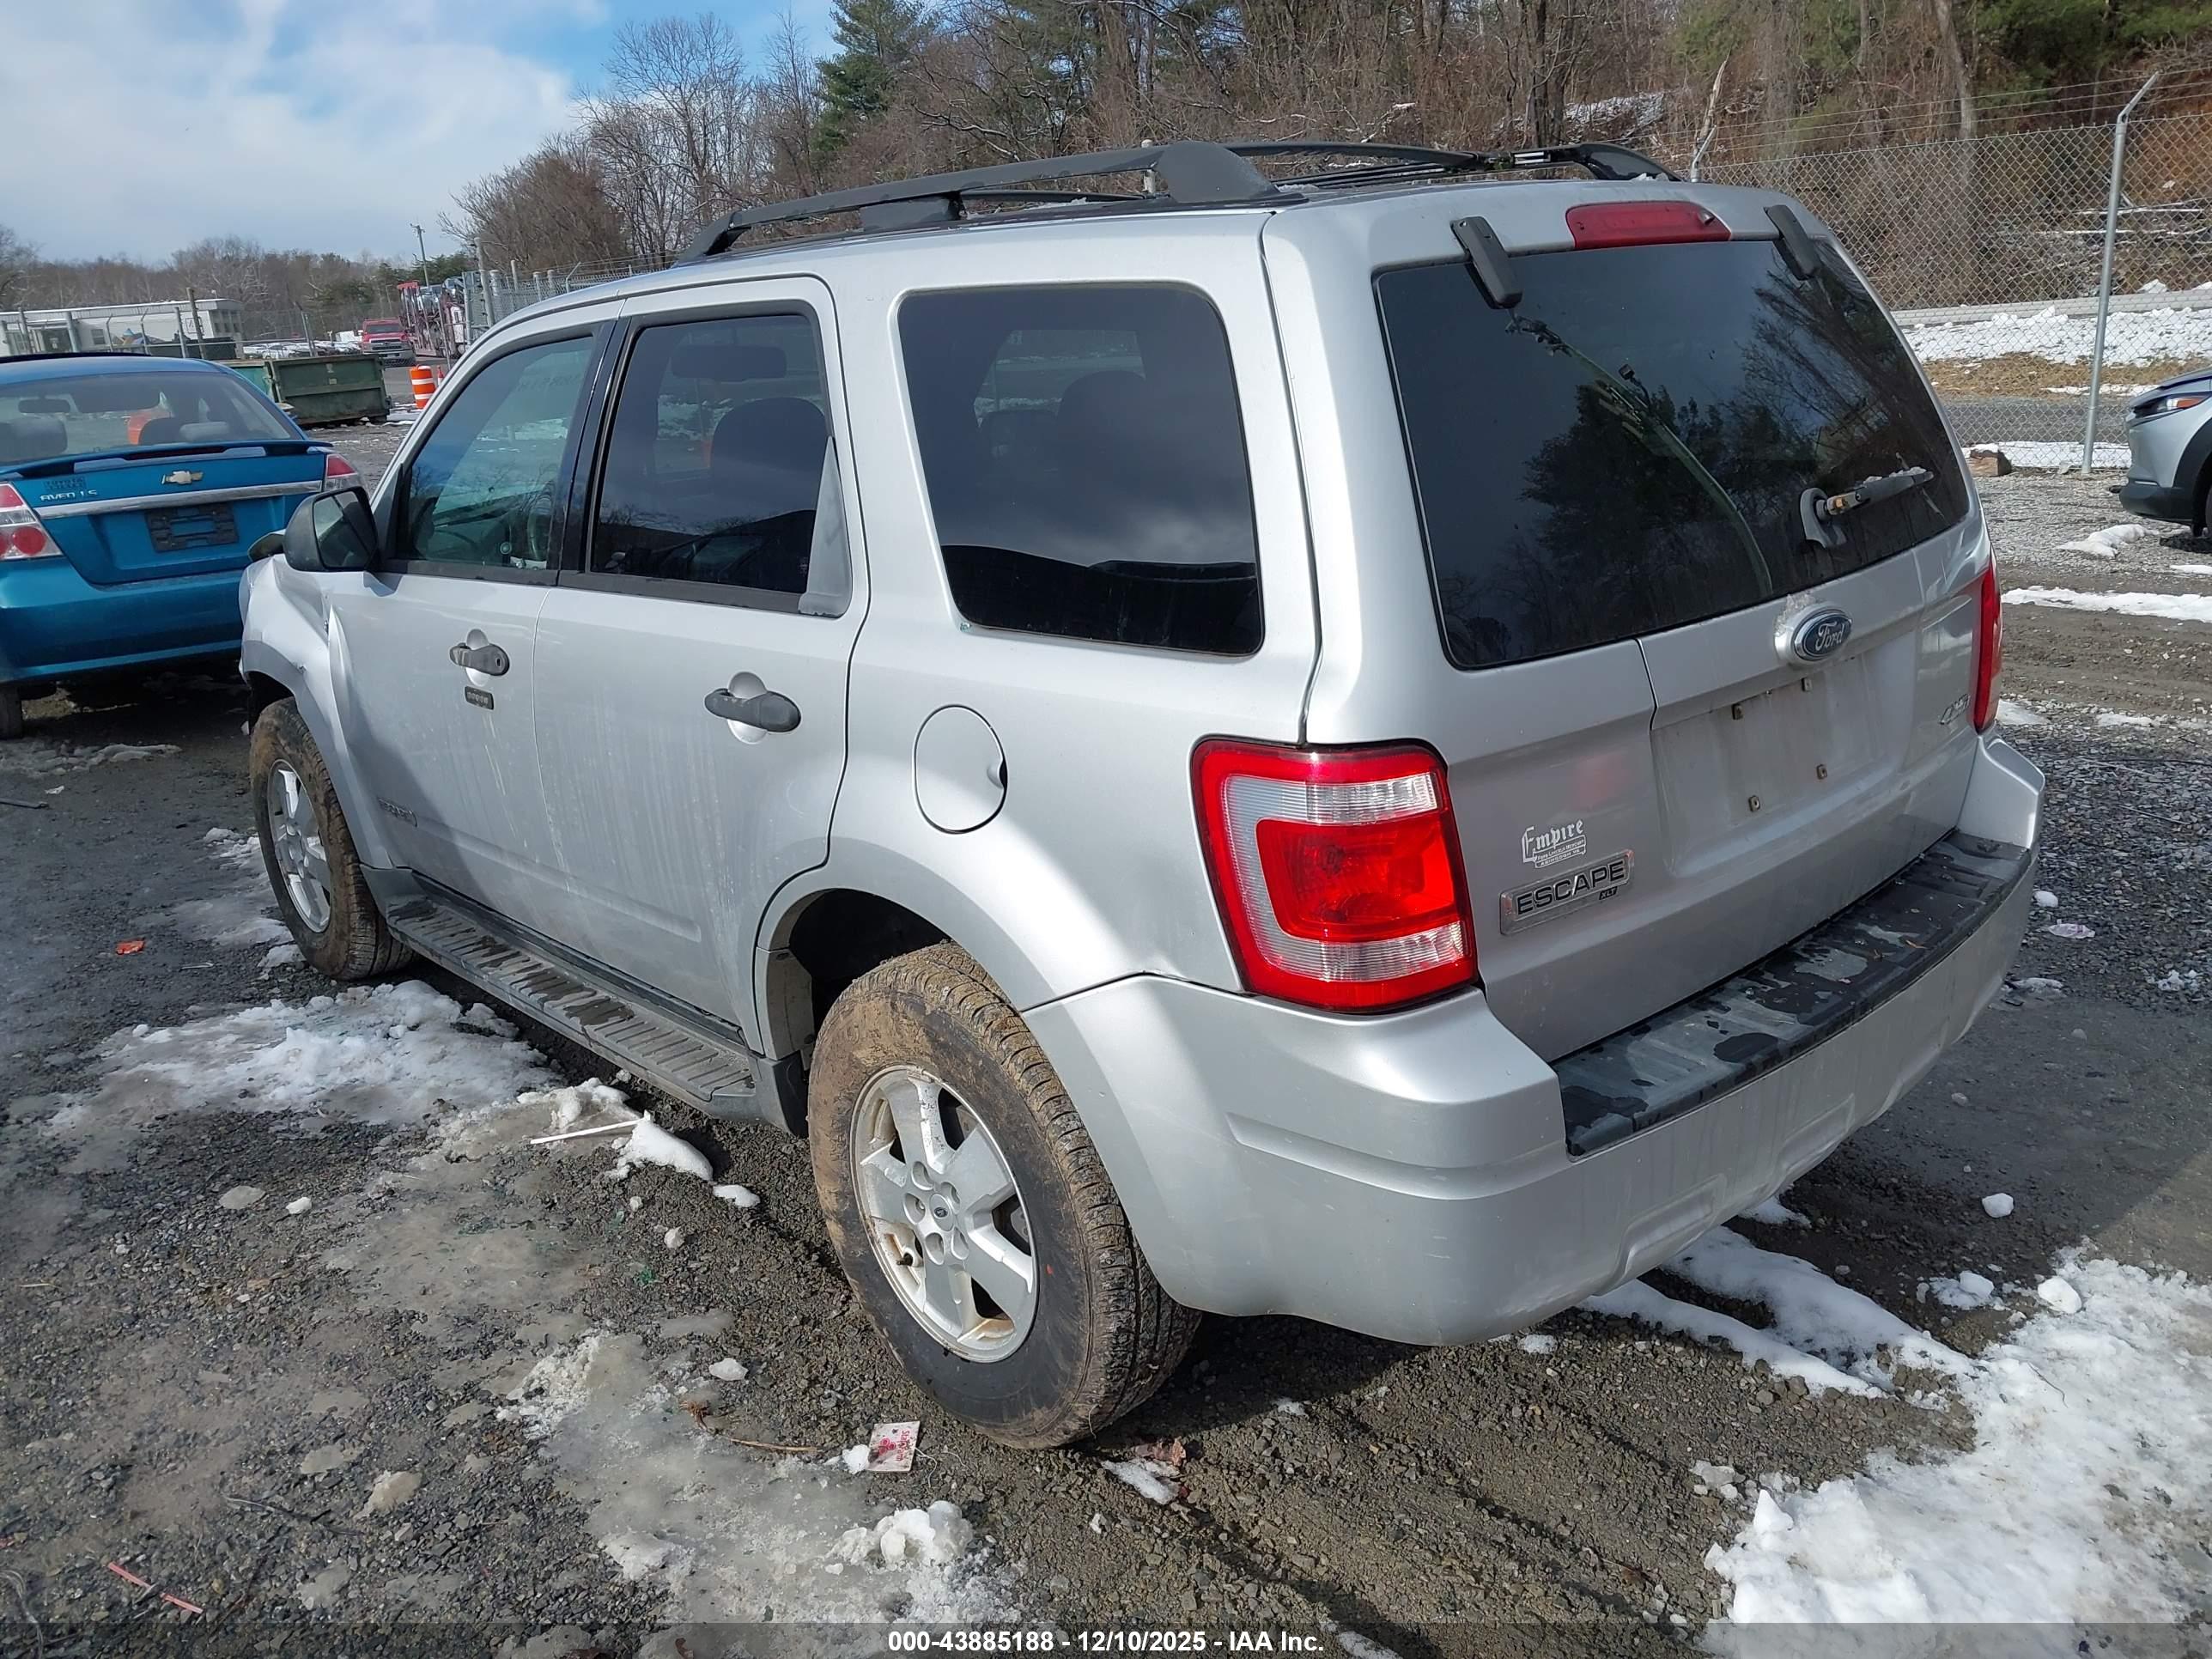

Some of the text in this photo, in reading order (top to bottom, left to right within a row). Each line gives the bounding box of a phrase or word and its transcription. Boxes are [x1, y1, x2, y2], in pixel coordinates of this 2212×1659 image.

[40, 492, 76, 501] AVEO
[1815, 621, 1844, 651] Ford
[1521, 819, 1583, 863] Empire
[1516, 860, 1626, 915] ESCAPE
[1600, 886, 1618, 899] XLT
